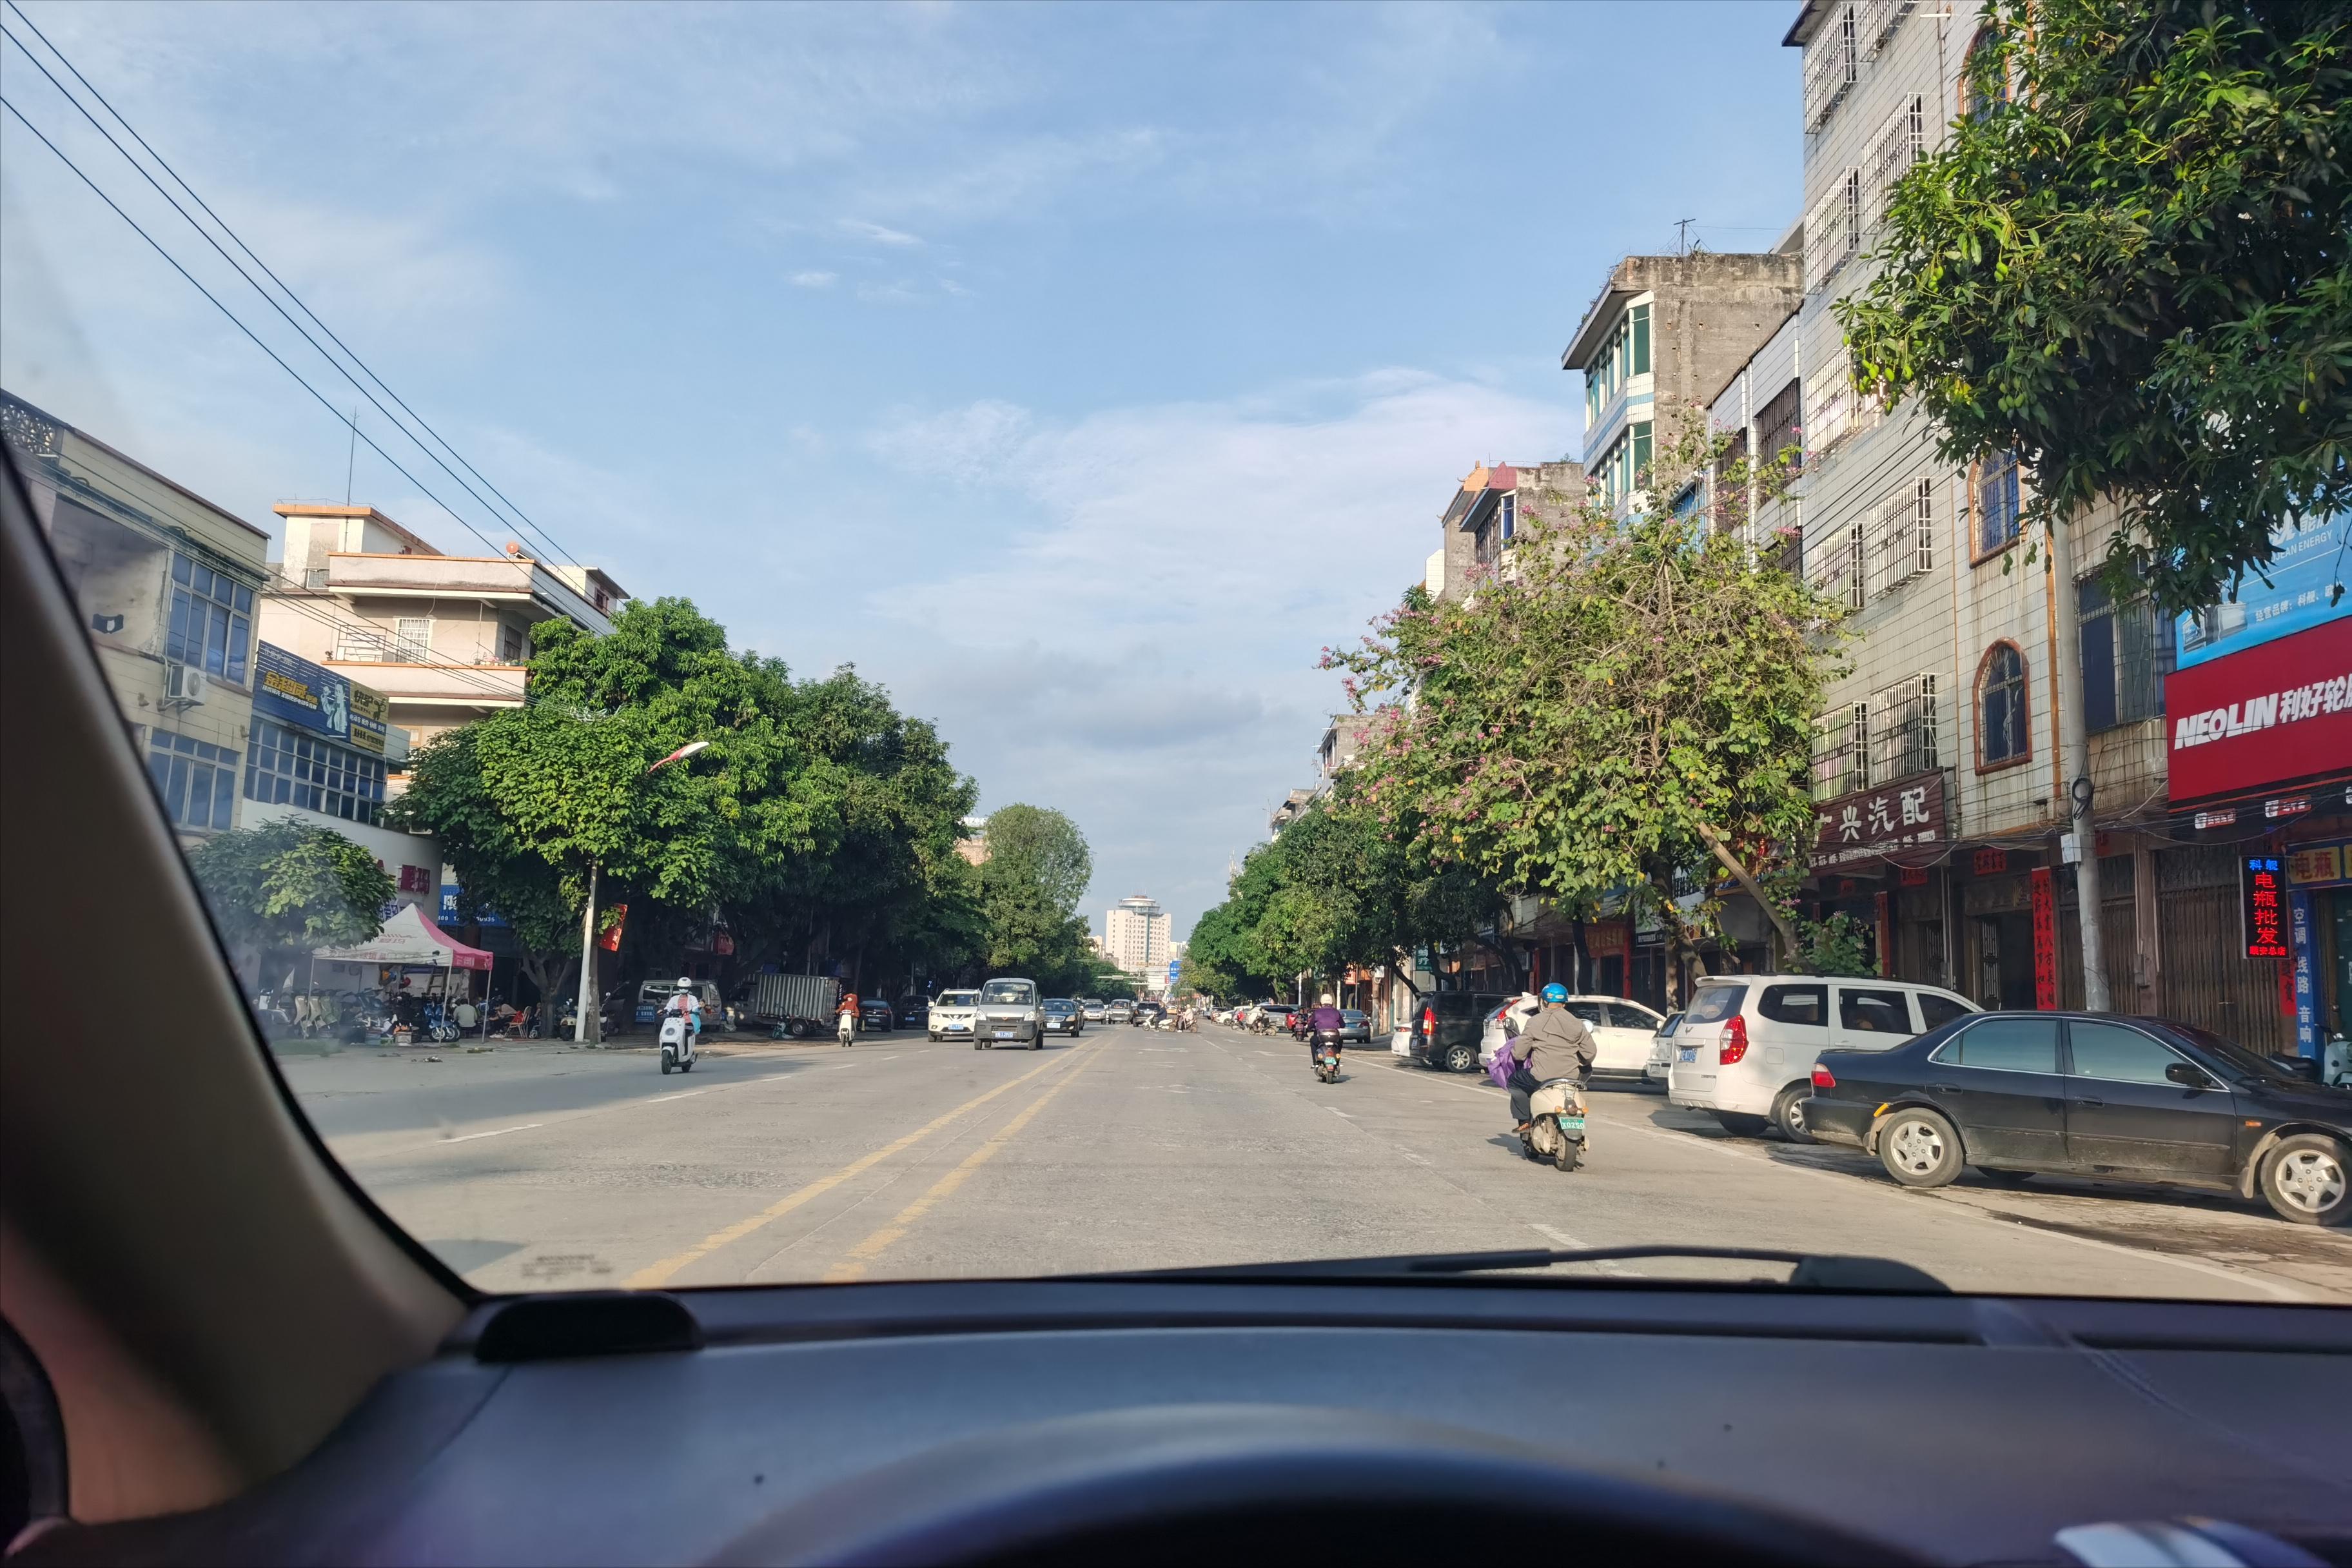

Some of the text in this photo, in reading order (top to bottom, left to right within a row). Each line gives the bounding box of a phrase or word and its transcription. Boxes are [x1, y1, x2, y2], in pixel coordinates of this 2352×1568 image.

[2298, 529, 2333, 552] ENERGY
[2174, 692, 2279, 750] NEOLIN
[2253, 871, 2278, 945] 电瓶批发
[2293, 907, 2307, 945] 空调
[2298, 1004, 2312, 1043] 音响
